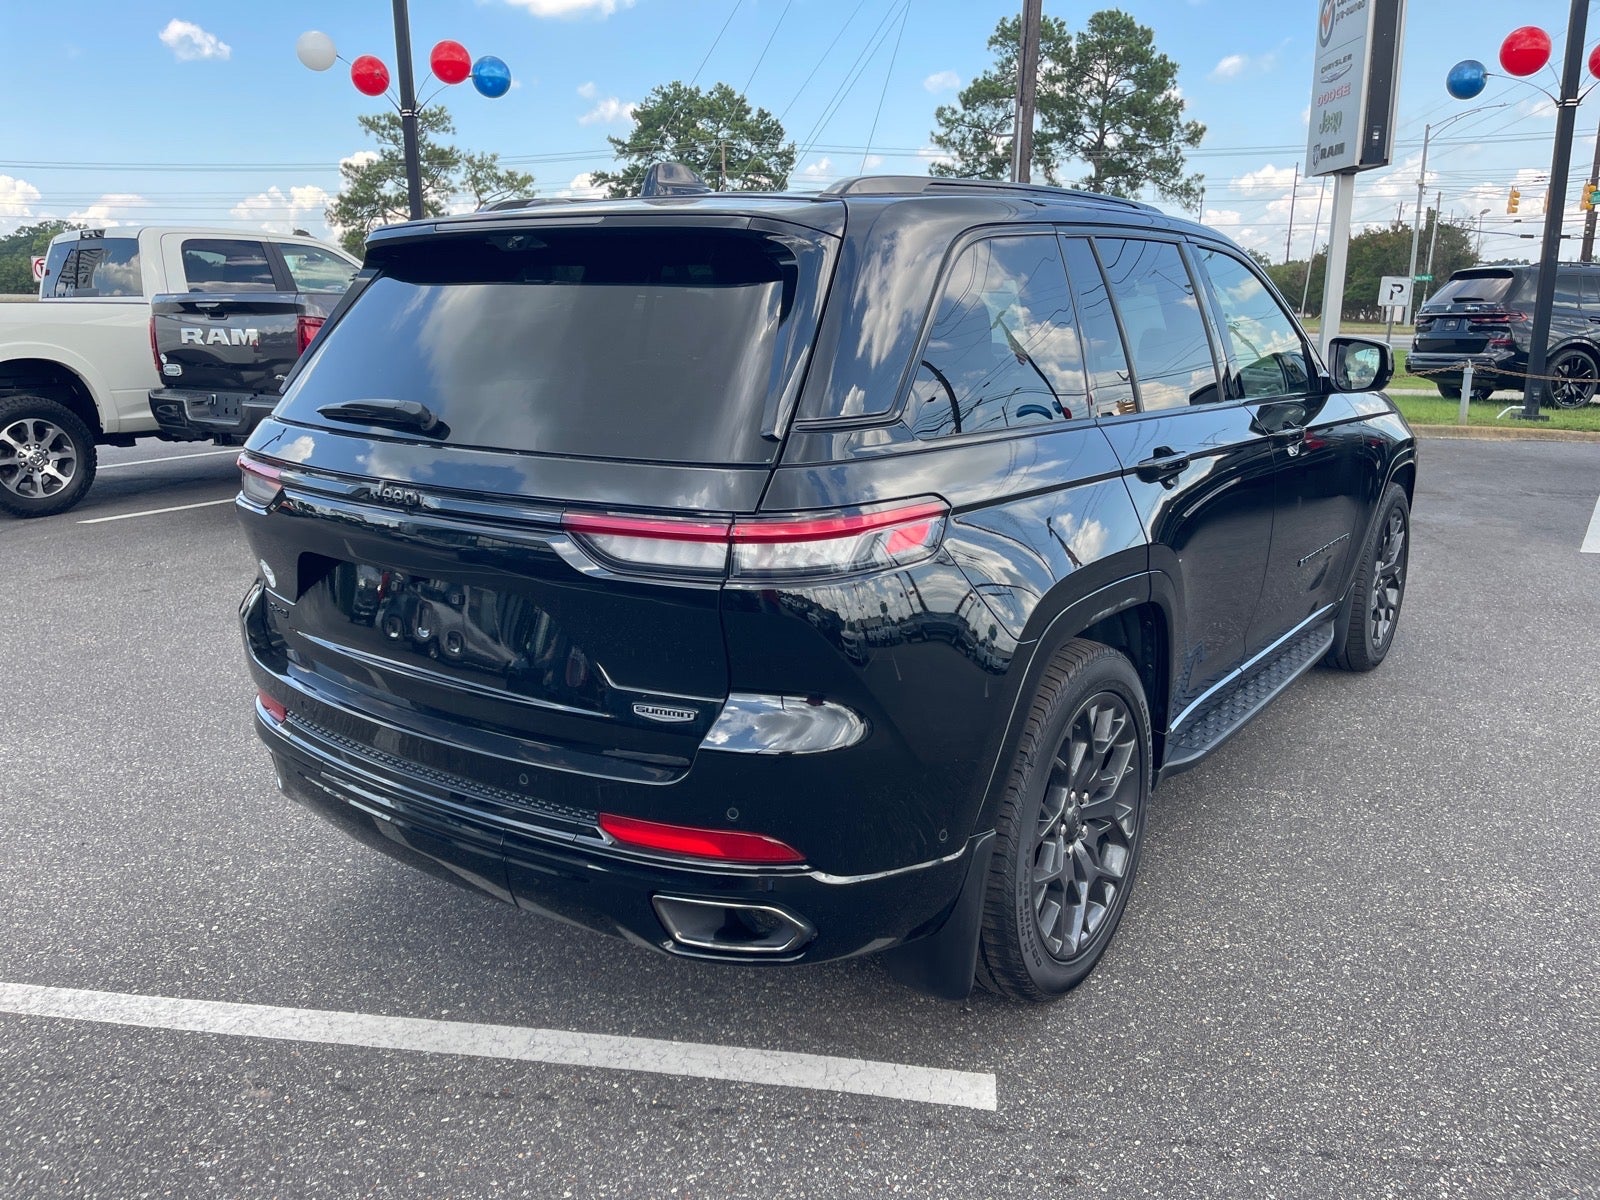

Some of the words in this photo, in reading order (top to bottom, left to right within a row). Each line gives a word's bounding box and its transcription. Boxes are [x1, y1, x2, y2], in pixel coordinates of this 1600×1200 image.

[1320, 53, 1352, 74] CHRYSLER
[1317, 82, 1352, 107] DODGE
[1319, 110, 1343, 135] Jeep
[1320, 142, 1345, 160] RAM
[180, 327, 259, 346] RAM
[371, 479, 424, 506] Jeep
[635, 704, 695, 719] SUMMIT
